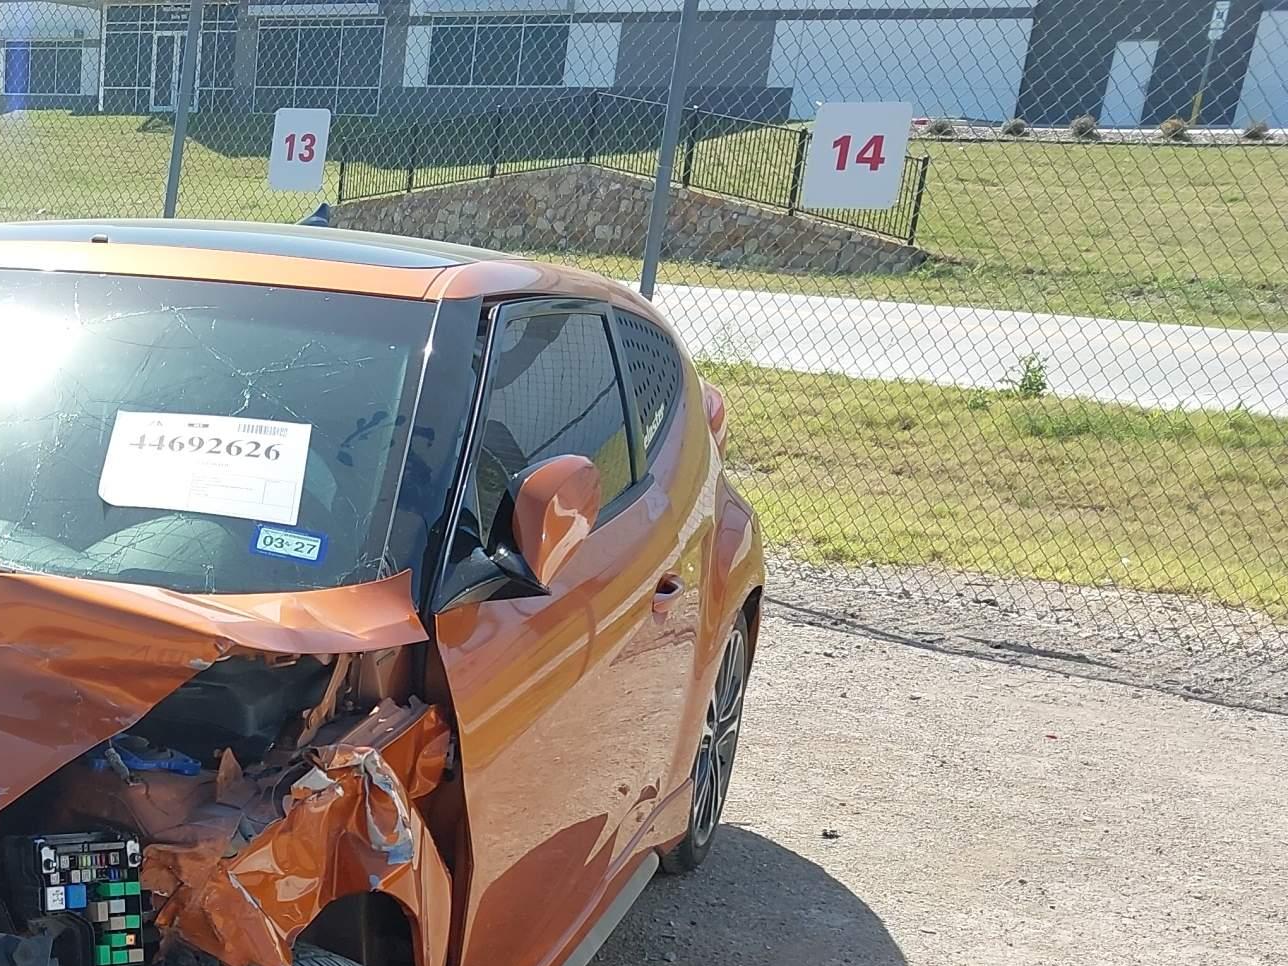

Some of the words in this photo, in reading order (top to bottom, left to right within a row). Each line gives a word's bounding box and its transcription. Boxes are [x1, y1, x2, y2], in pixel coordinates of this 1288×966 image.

[285, 133, 316, 162] 13
[832, 135, 885, 171] 14
[129, 433, 284, 461] 44692626
